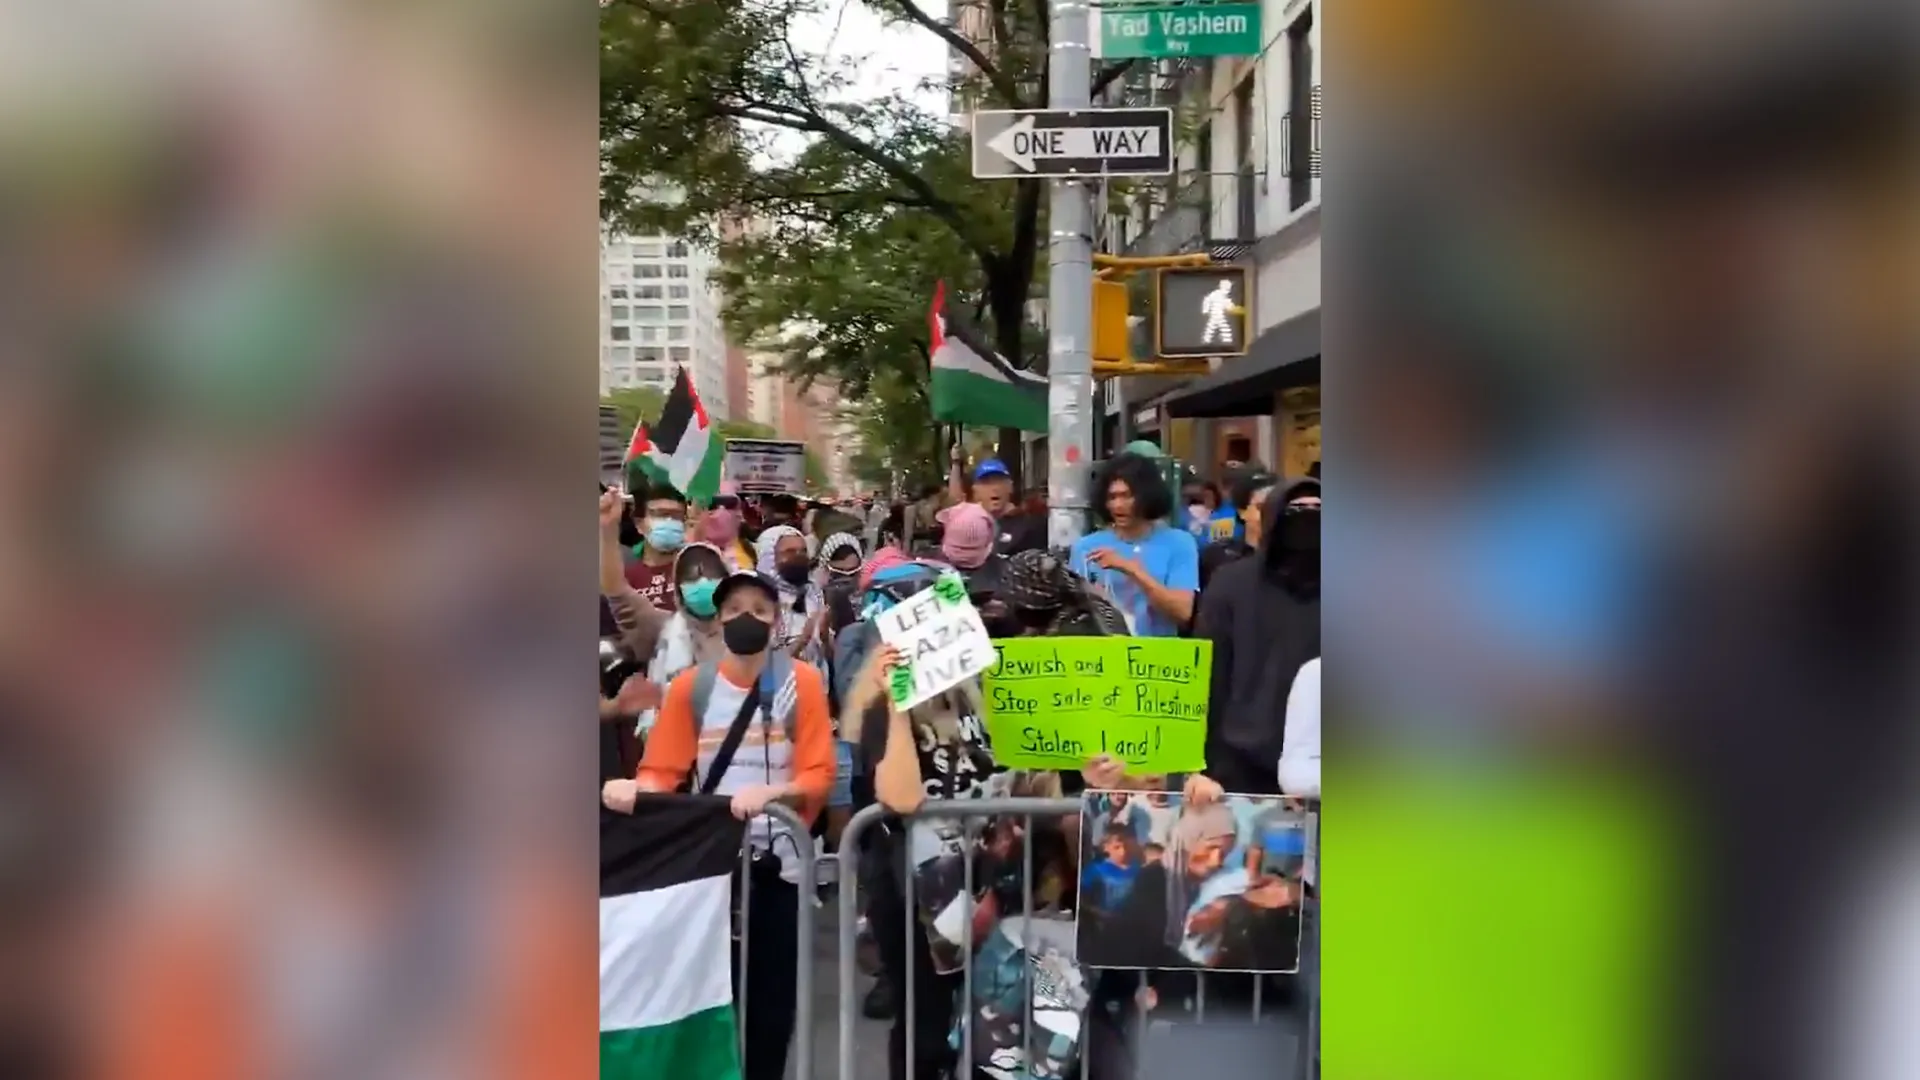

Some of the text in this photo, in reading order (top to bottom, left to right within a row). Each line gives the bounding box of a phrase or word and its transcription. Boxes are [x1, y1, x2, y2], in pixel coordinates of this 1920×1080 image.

[1108, 12, 1248, 35] Yad Vashem
[1013, 130, 1149, 155] ONE WAY
[896, 596, 942, 632] LET
[989, 646, 1200, 679] Jewish and Furious!
[992, 687, 1038, 716] Stop
[1052, 687, 1093, 708] sale
[1102, 686, 1121, 707] of
[1020, 727, 1084, 756] Stolen
